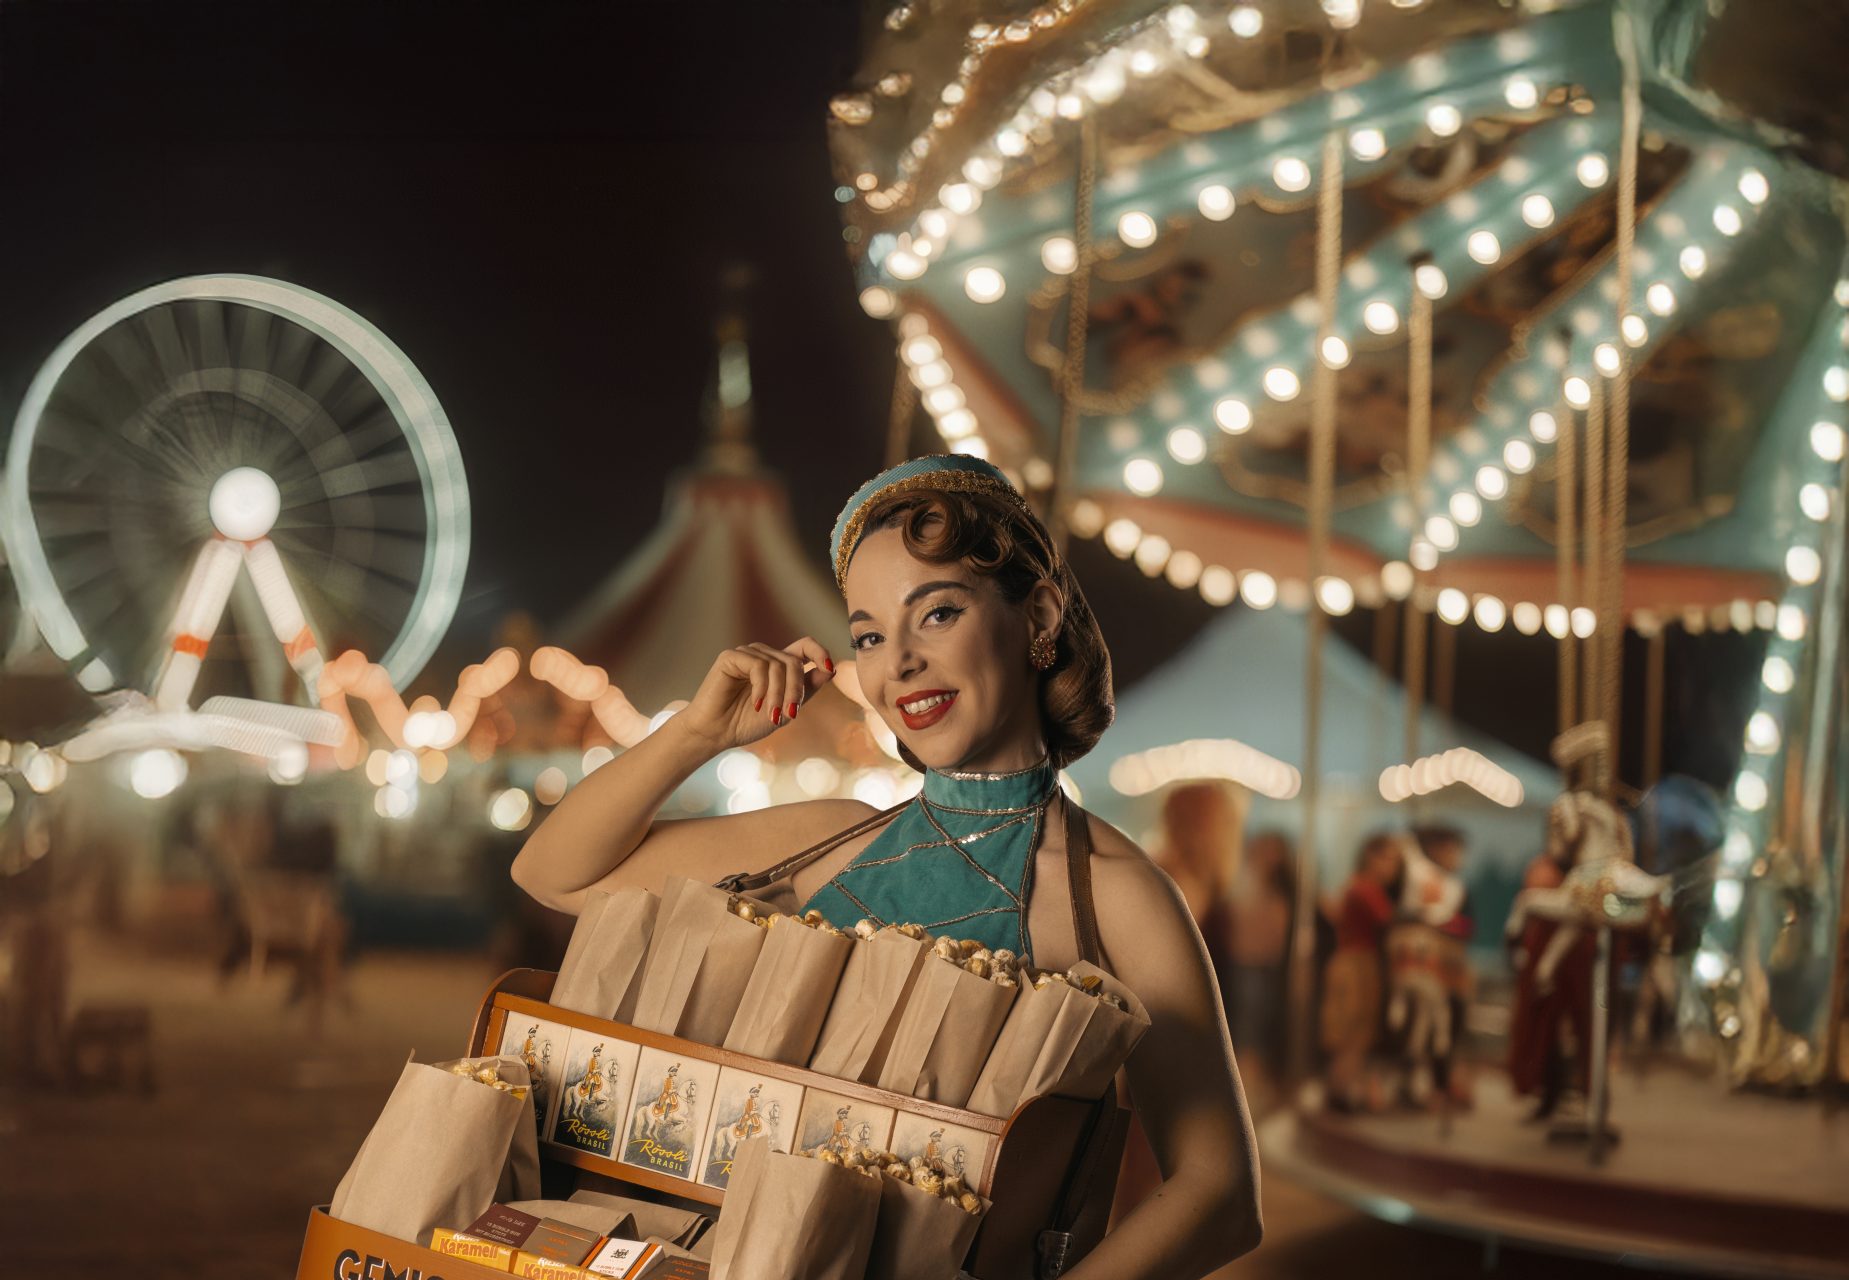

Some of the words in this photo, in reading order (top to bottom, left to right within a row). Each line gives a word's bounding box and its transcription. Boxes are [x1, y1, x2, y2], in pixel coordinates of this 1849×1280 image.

[560, 1118, 610, 1142] Rössli
[577, 1136, 607, 1150] BRASIL
[629, 1139, 689, 1163] Rössli
[650, 1156, 683, 1172] BRASIL
[440, 1237, 499, 1259] Karamell
